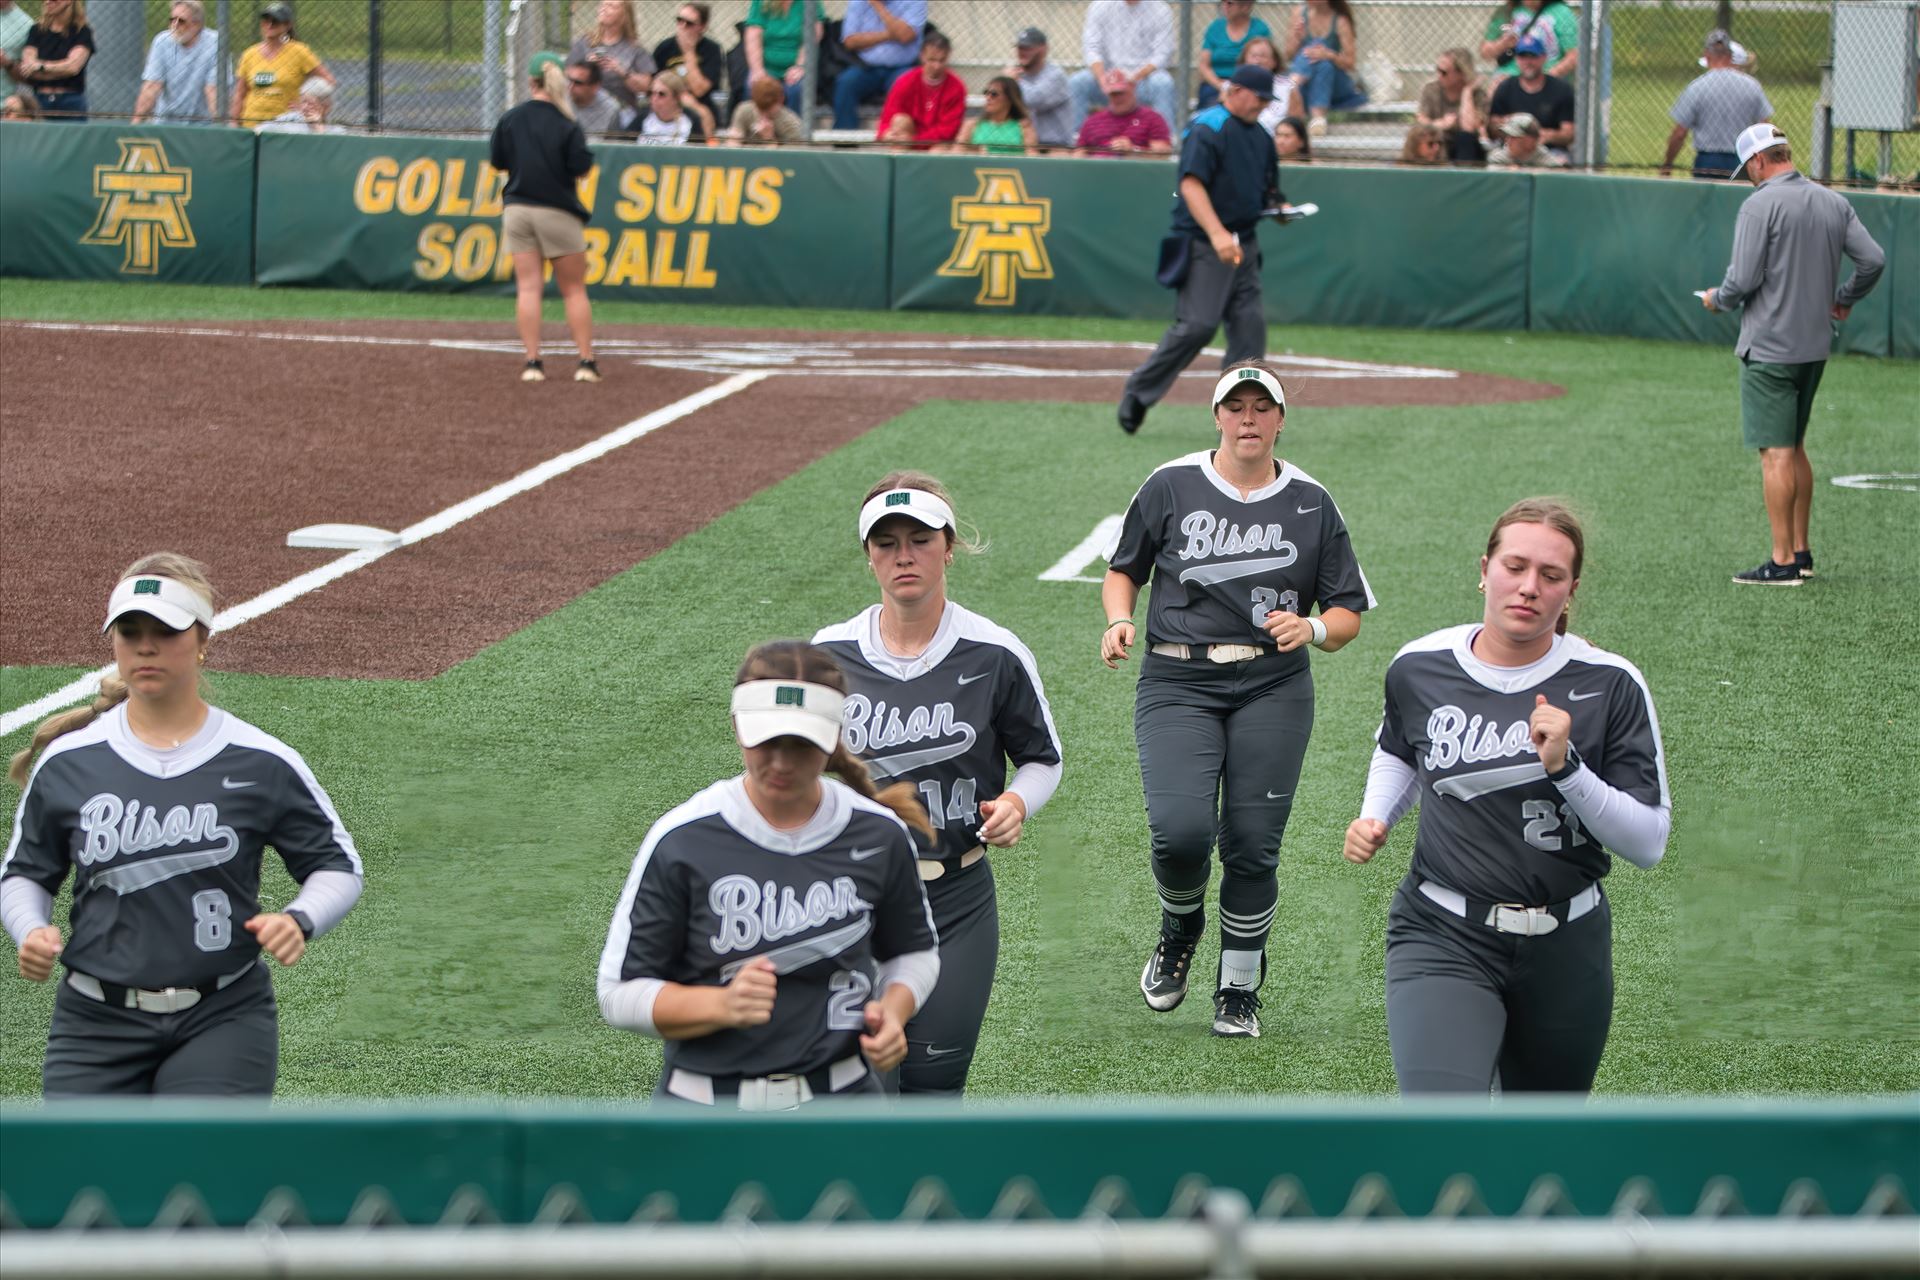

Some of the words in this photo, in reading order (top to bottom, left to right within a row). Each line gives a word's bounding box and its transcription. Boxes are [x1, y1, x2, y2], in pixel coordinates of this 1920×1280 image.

[353, 156, 600, 217] GOLD
[614, 163, 785, 226] SUNS
[413, 222, 718, 288] SOBALL
[1178, 510, 1298, 560] Bison
[842, 693, 976, 754] Bison
[1424, 705, 1538, 771] Biso
[78, 793, 239, 866] Bison
[919, 777, 977, 830] 14
[192, 887, 232, 952] 8
[708, 874, 874, 954] Bison
